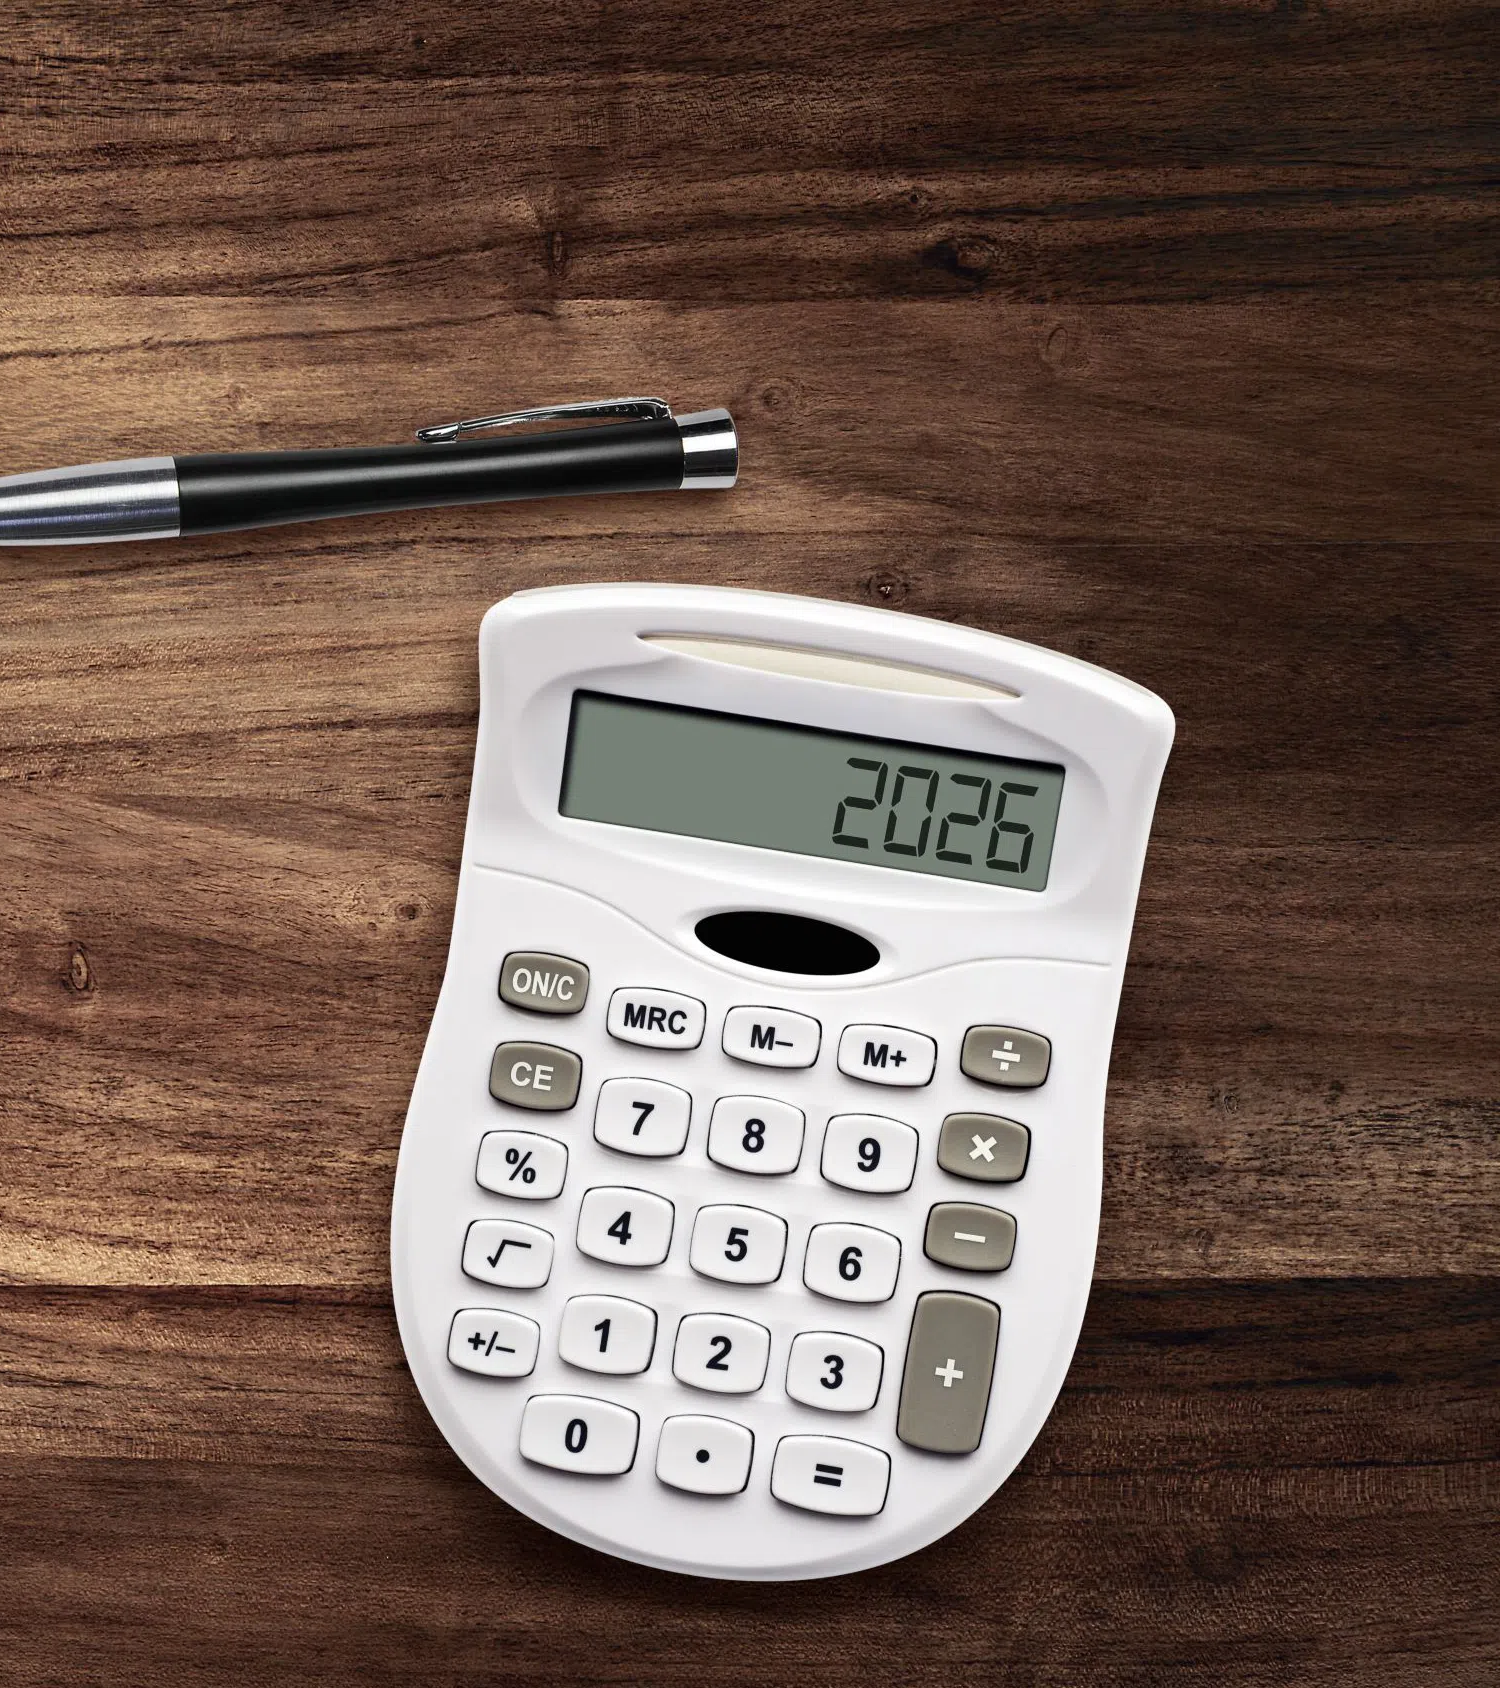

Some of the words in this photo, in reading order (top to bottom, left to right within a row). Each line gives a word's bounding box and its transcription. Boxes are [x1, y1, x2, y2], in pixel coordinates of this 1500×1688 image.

[831, 756, 1040, 874] 2026
[511, 966, 575, 1002] ON/C
[623, 1002, 688, 1035] MRC
[863, 1041, 907, 1068] M+
[510, 1061, 554, 1091] CE
[632, 1101, 655, 1136] 7
[742, 1118, 766, 1154] 8
[505, 1148, 536, 1184] %
[857, 1137, 881, 1173] 9
[607, 1211, 632, 1246] 4
[724, 1226, 749, 1262] 5
[838, 1246, 863, 1282] 6
[594, 1318, 611, 1353] 1
[705, 1335, 732, 1371] 2
[819, 1354, 845, 1390] 3
[564, 1418, 588, 1454] 0
